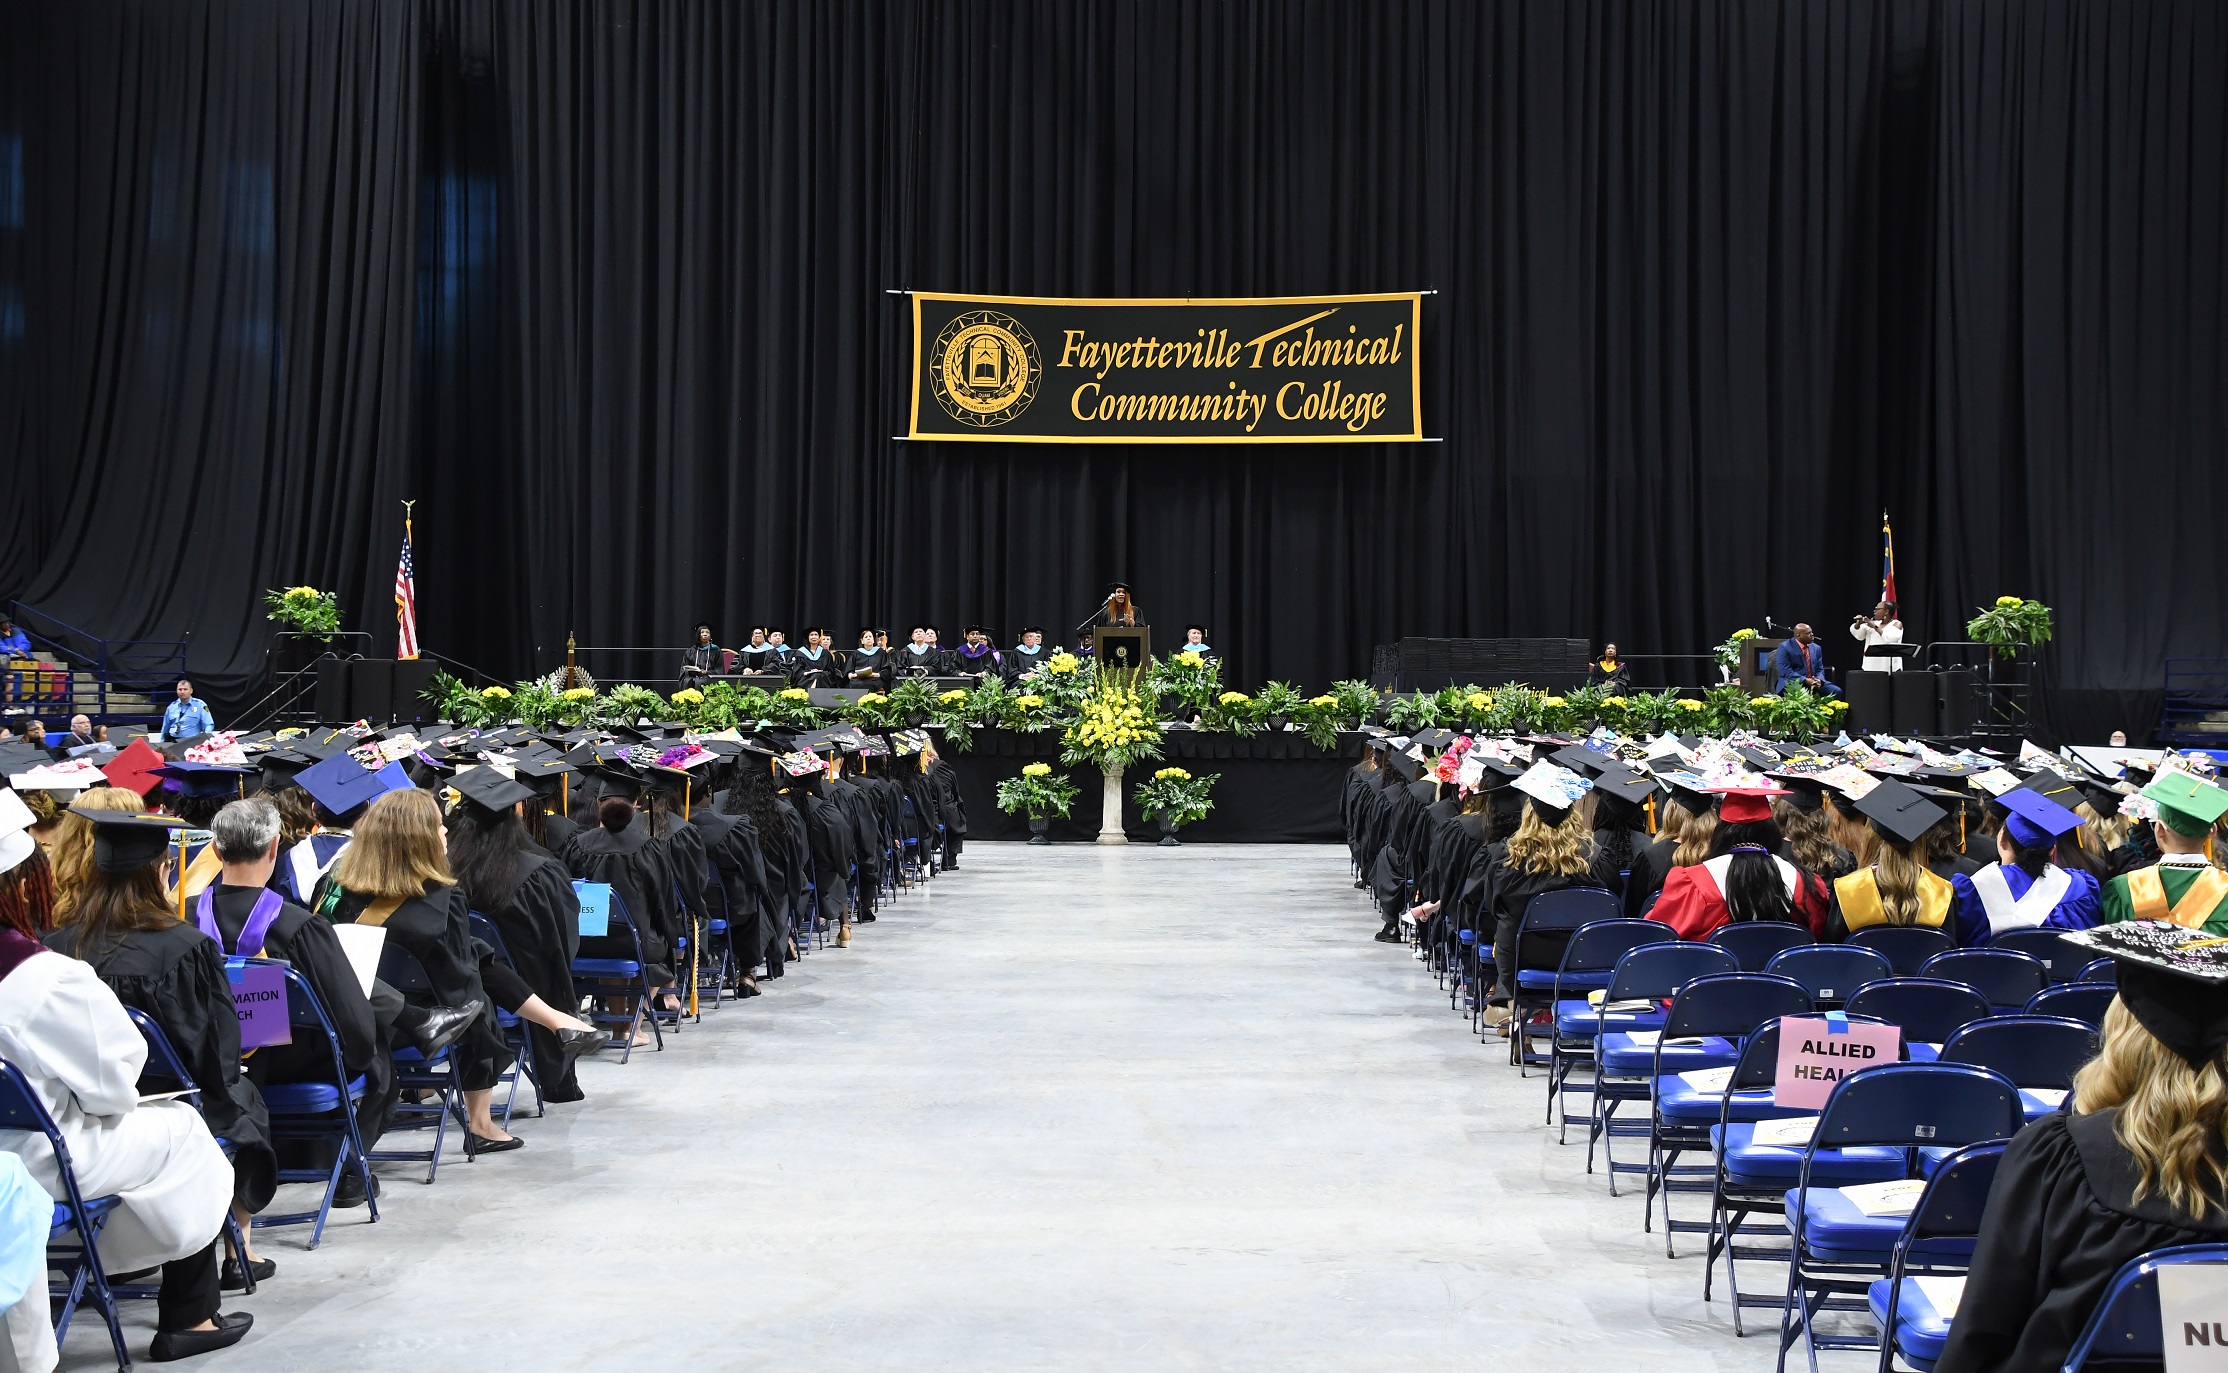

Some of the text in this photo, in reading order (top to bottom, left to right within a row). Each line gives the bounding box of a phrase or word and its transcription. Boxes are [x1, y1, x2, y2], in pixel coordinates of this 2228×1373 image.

[945, 326, 1027, 383] FAYETTEVILLE TECHNICAL COMMUNITY COLLEGE
[1057, 307, 1403, 380] Fayetteville Technical
[961, 399, 996, 412] ESTABLISHED
[1071, 380, 1387, 432] Community College
[581, 906, 595, 914] ESS
[1801, 1040, 1876, 1059] ALLIED
[1794, 1064, 1856, 1082] HEAL
[2183, 1322, 2228, 1347] NU
